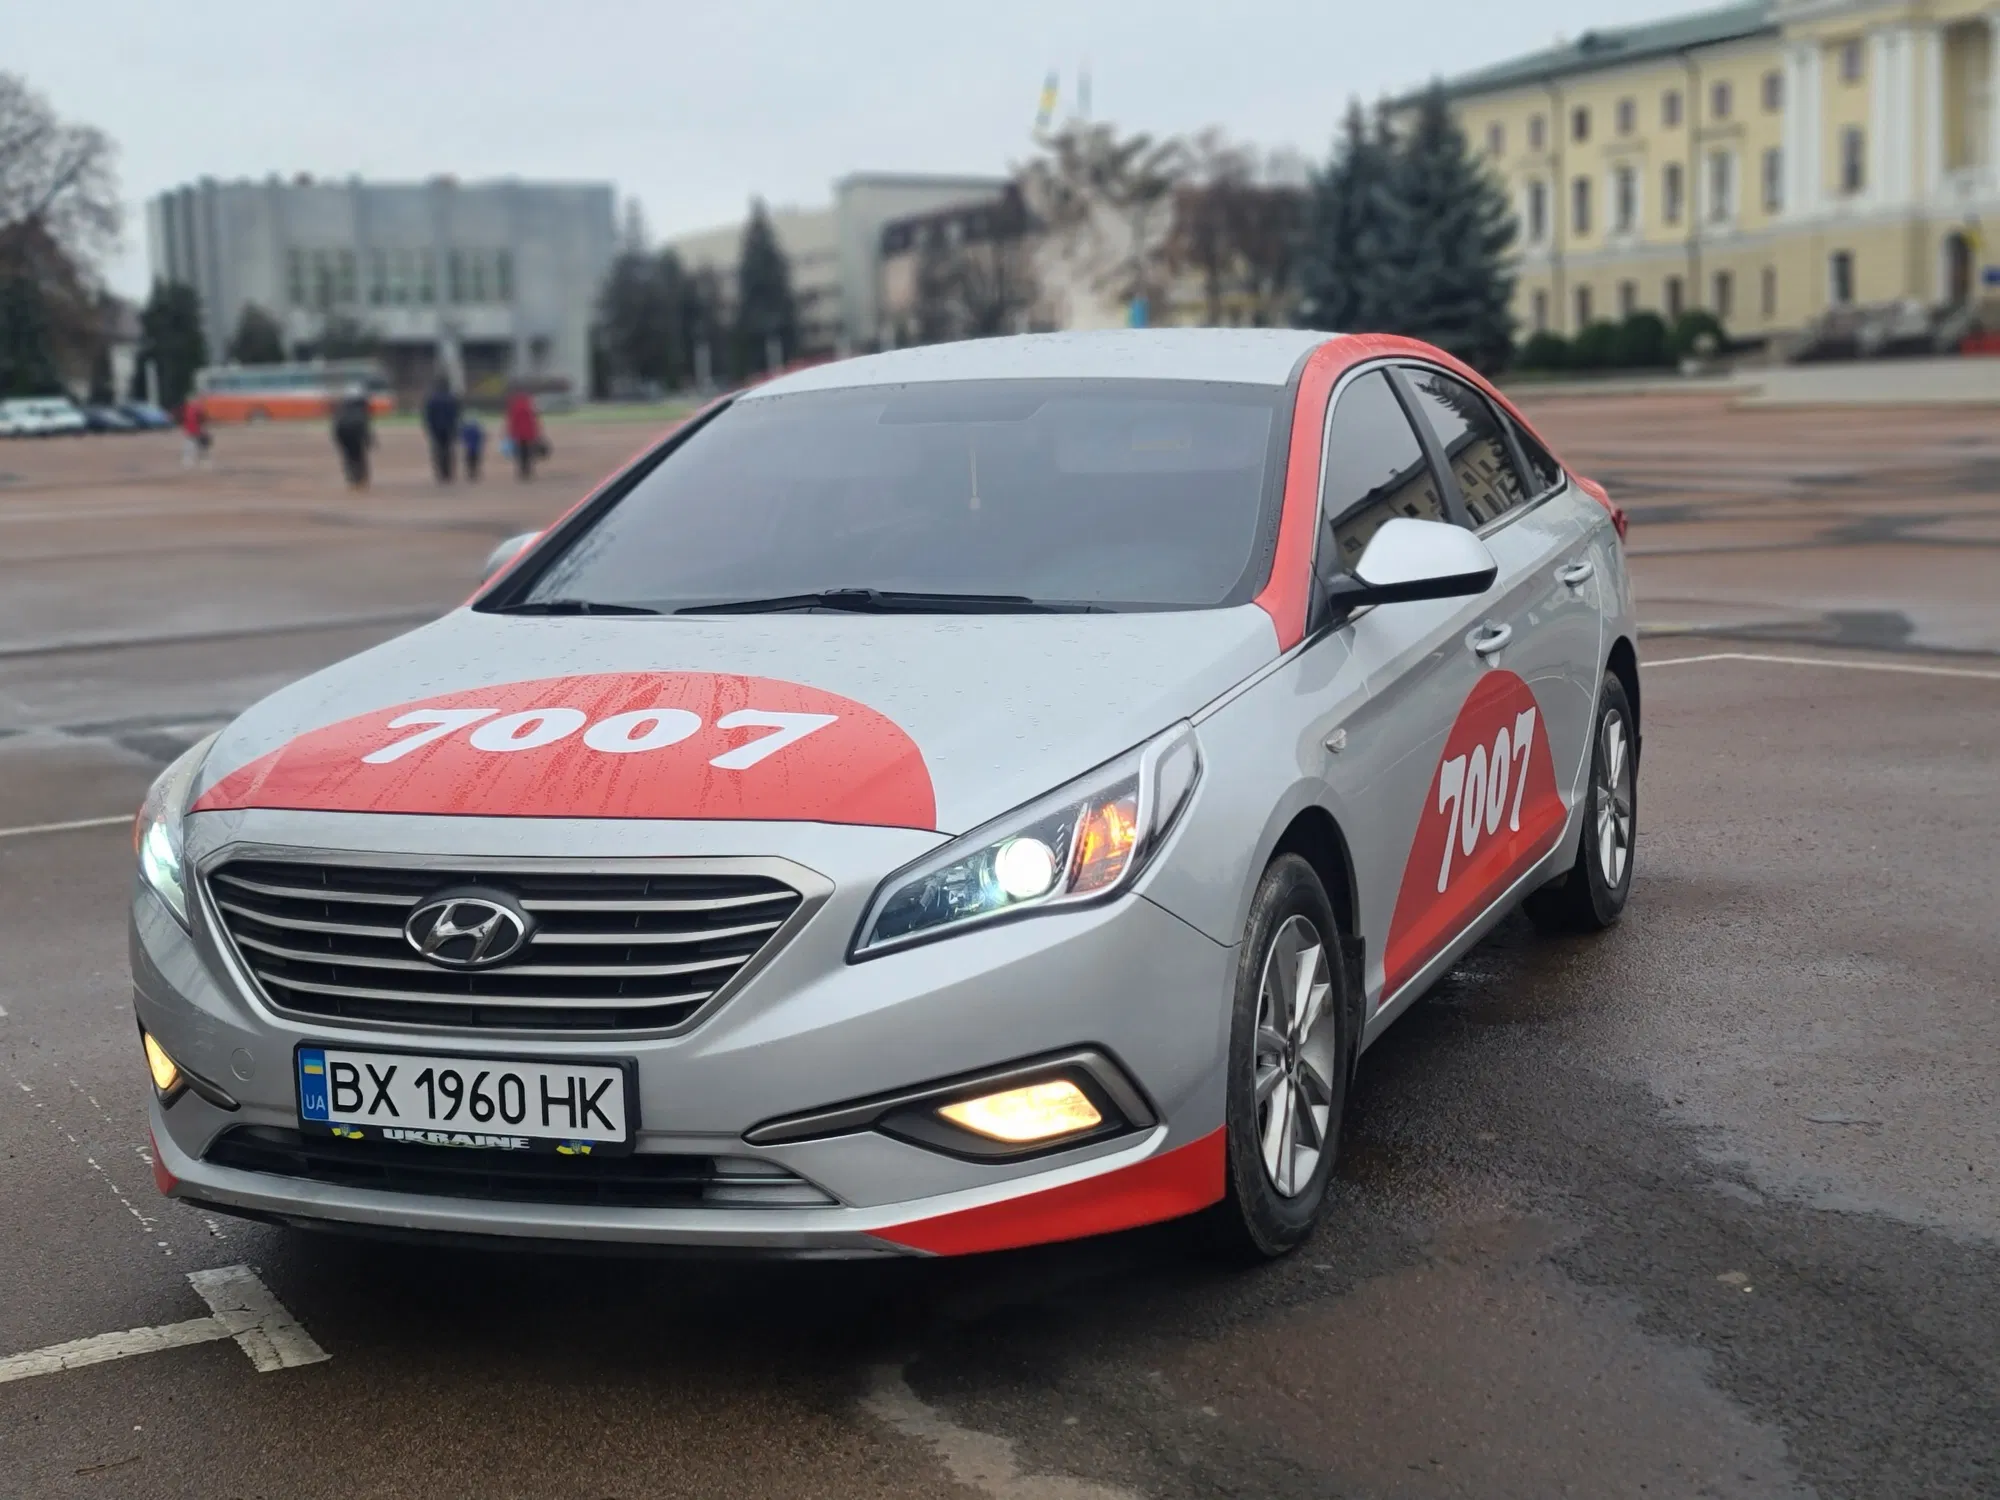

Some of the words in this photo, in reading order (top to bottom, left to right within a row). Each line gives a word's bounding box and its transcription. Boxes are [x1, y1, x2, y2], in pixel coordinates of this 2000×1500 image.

[361, 707, 840, 770] 7007
[1437, 706, 1536, 894] 7007
[305, 1094, 326, 1112] UA
[329, 1061, 400, 1117] BX
[413, 1067, 526, 1125] 1960
[539, 1074, 617, 1131] HK
[382, 1127, 531, 1150] UKRAINE
